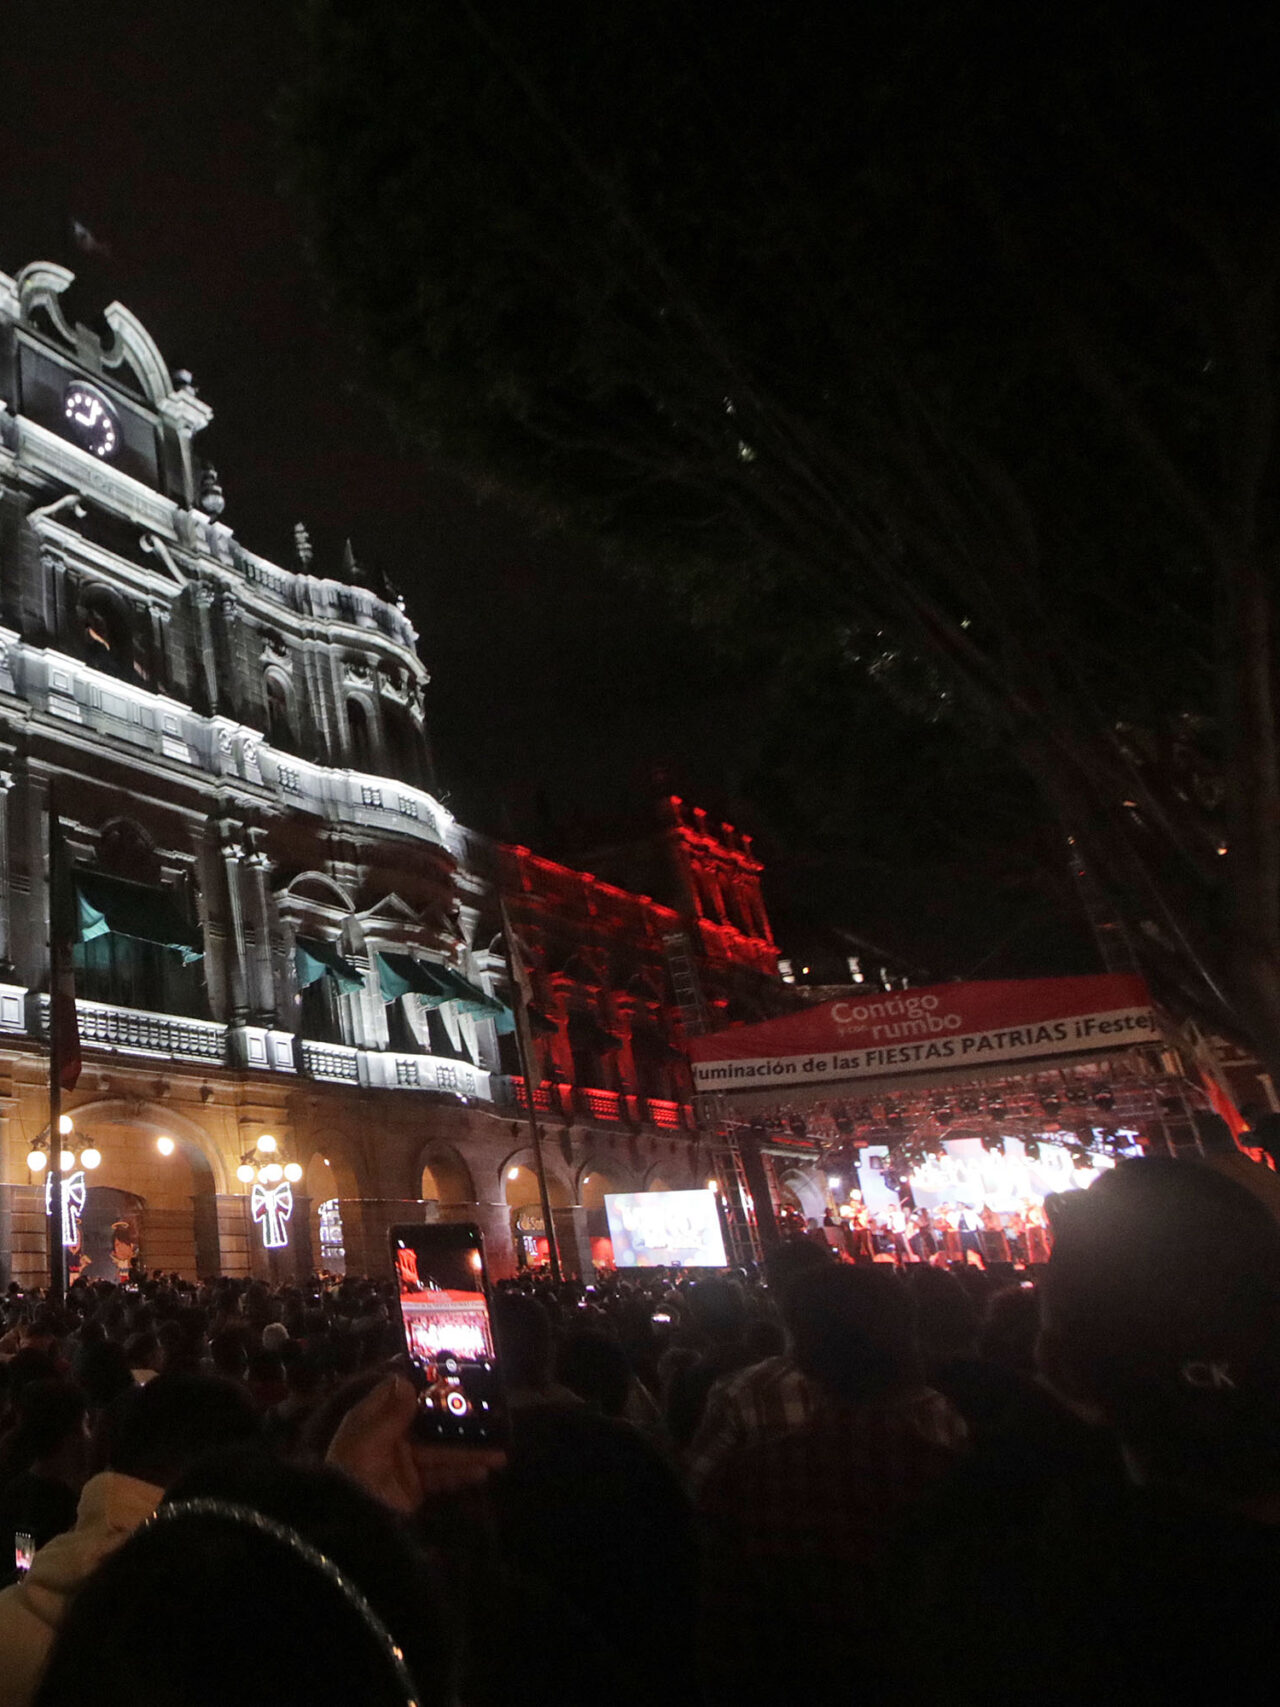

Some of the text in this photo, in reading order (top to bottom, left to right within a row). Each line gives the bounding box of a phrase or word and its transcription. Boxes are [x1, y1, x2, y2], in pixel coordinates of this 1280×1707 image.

[831, 995, 939, 1023] Contigo
[872, 1012, 962, 1040] rumbo
[802, 1058, 827, 1073] de
[833, 1056, 860, 1070] las
[865, 1040, 955, 1067] FIESTAS
[961, 1023, 1067, 1054] PATRIAS
